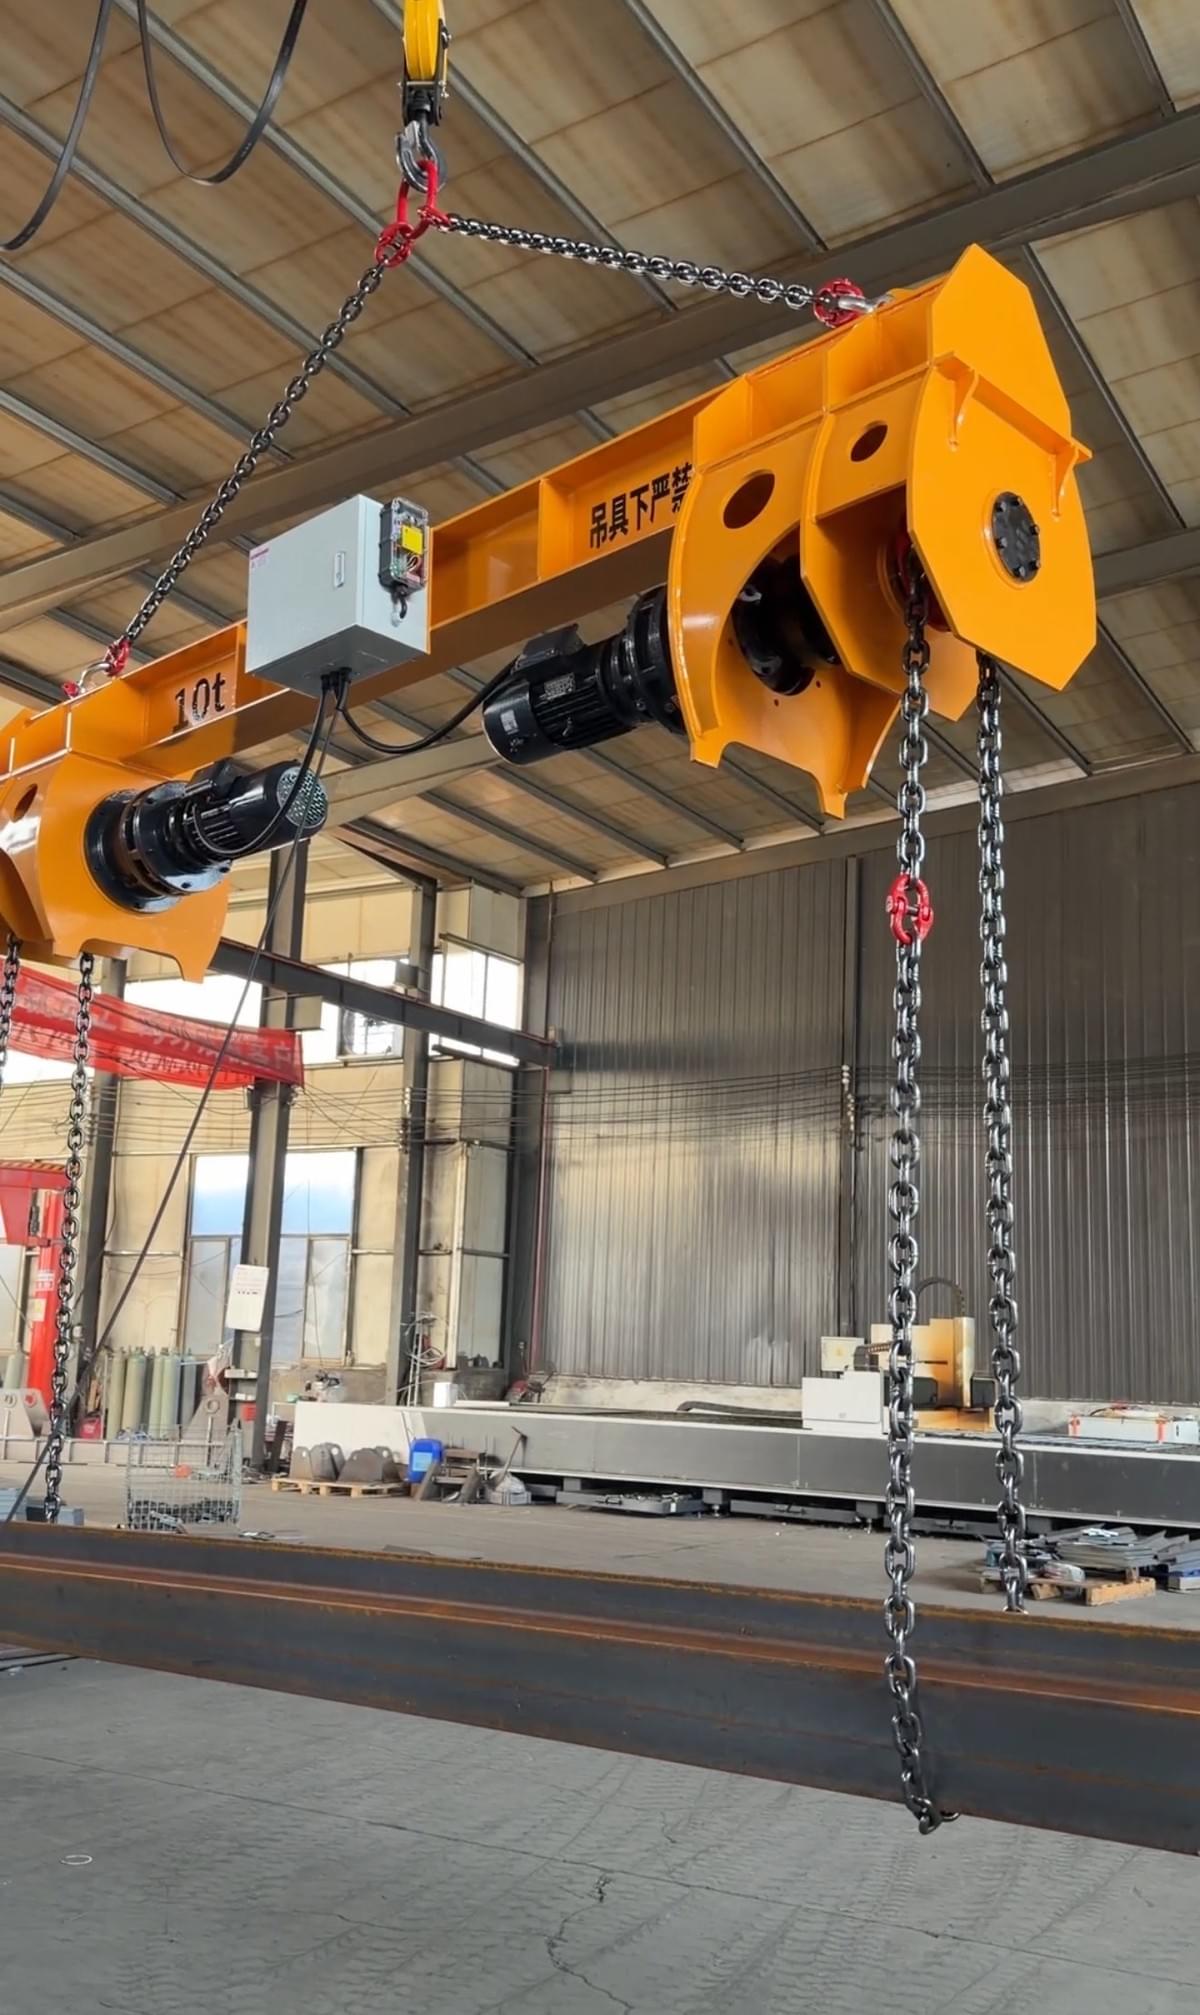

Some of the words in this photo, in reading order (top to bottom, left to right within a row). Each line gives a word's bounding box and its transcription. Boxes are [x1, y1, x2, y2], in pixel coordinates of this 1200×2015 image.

[590, 462, 692, 549] 吊具下严禁
[173, 672, 226, 733] 10t
